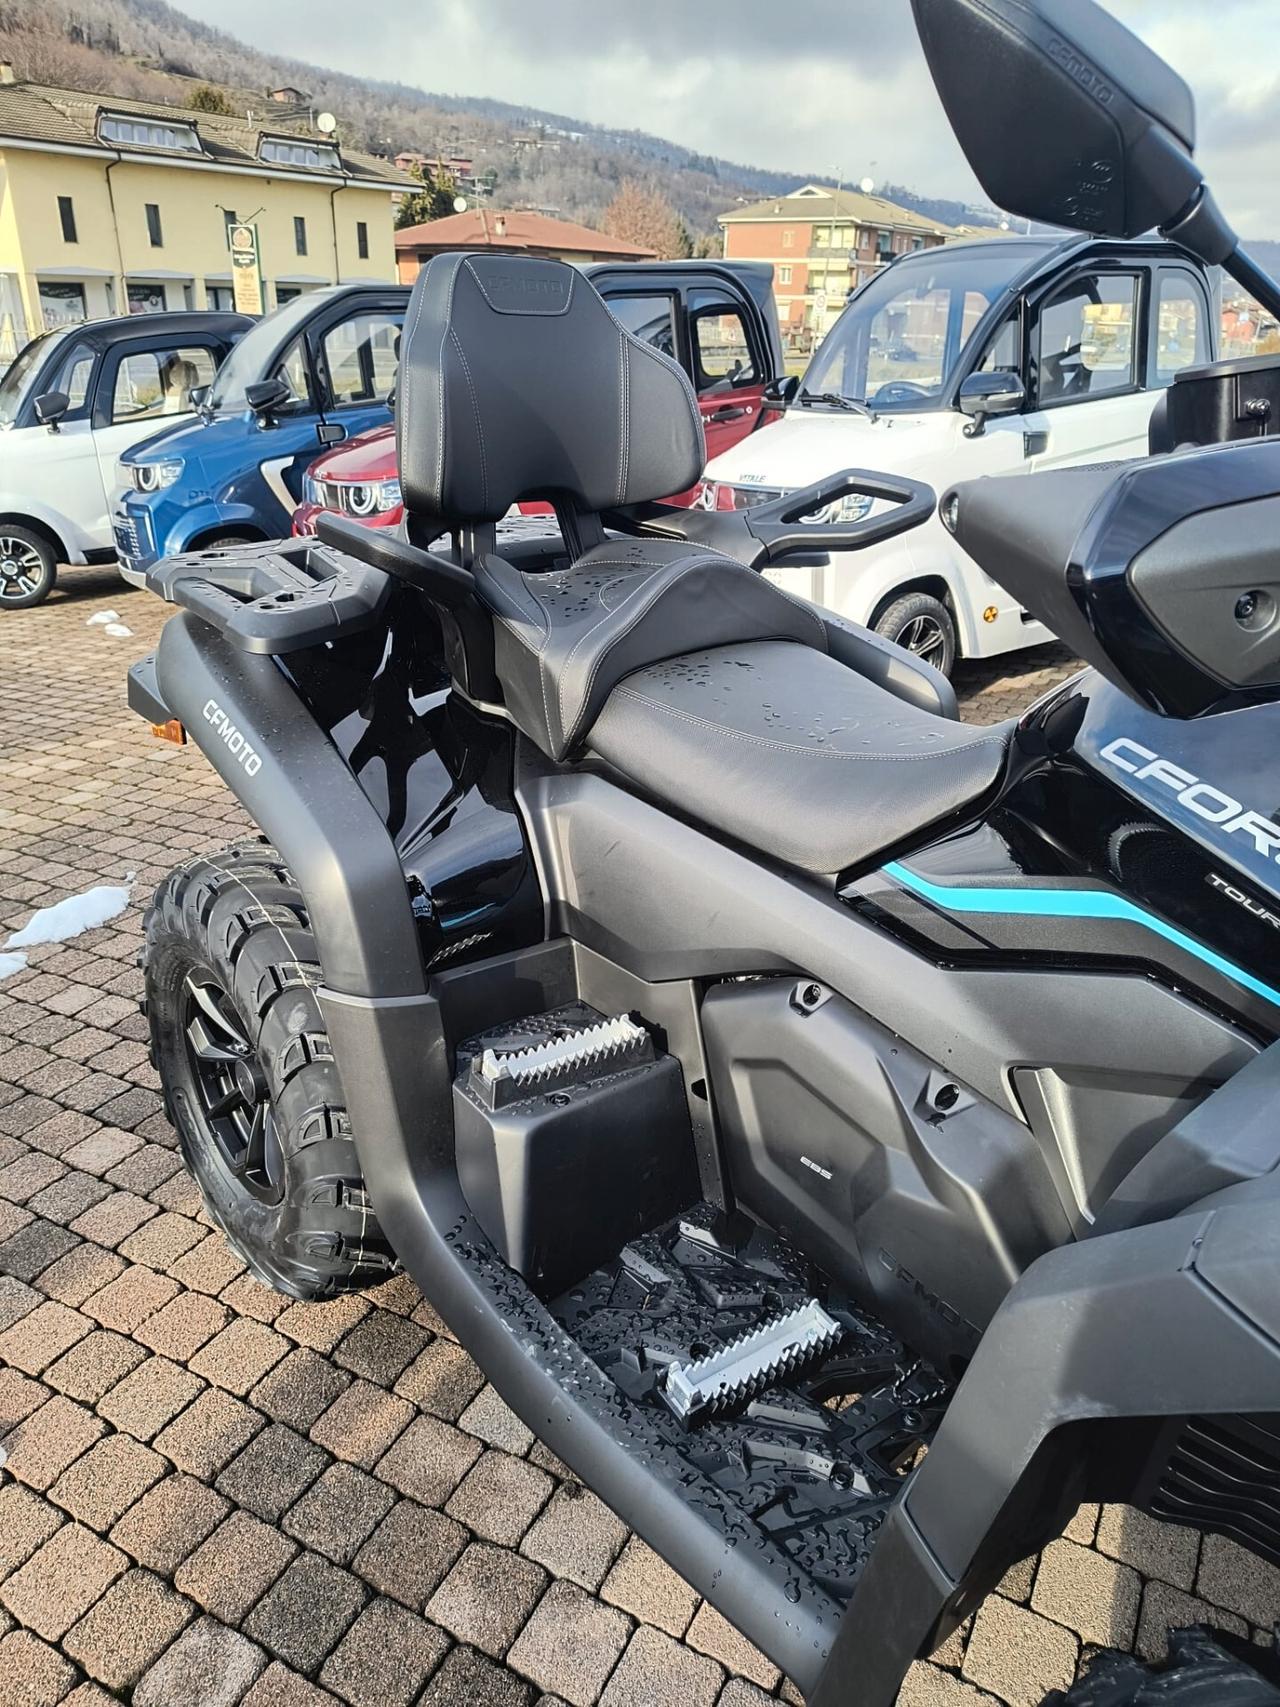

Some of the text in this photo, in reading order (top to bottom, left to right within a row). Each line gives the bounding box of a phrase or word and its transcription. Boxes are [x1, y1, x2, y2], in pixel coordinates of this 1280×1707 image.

[1048, 37, 1114, 105] CFMOTO
[738, 473, 767, 483] VITALE
[201, 698, 263, 777] CFMOTO
[1099, 737, 1280, 866] CFOR
